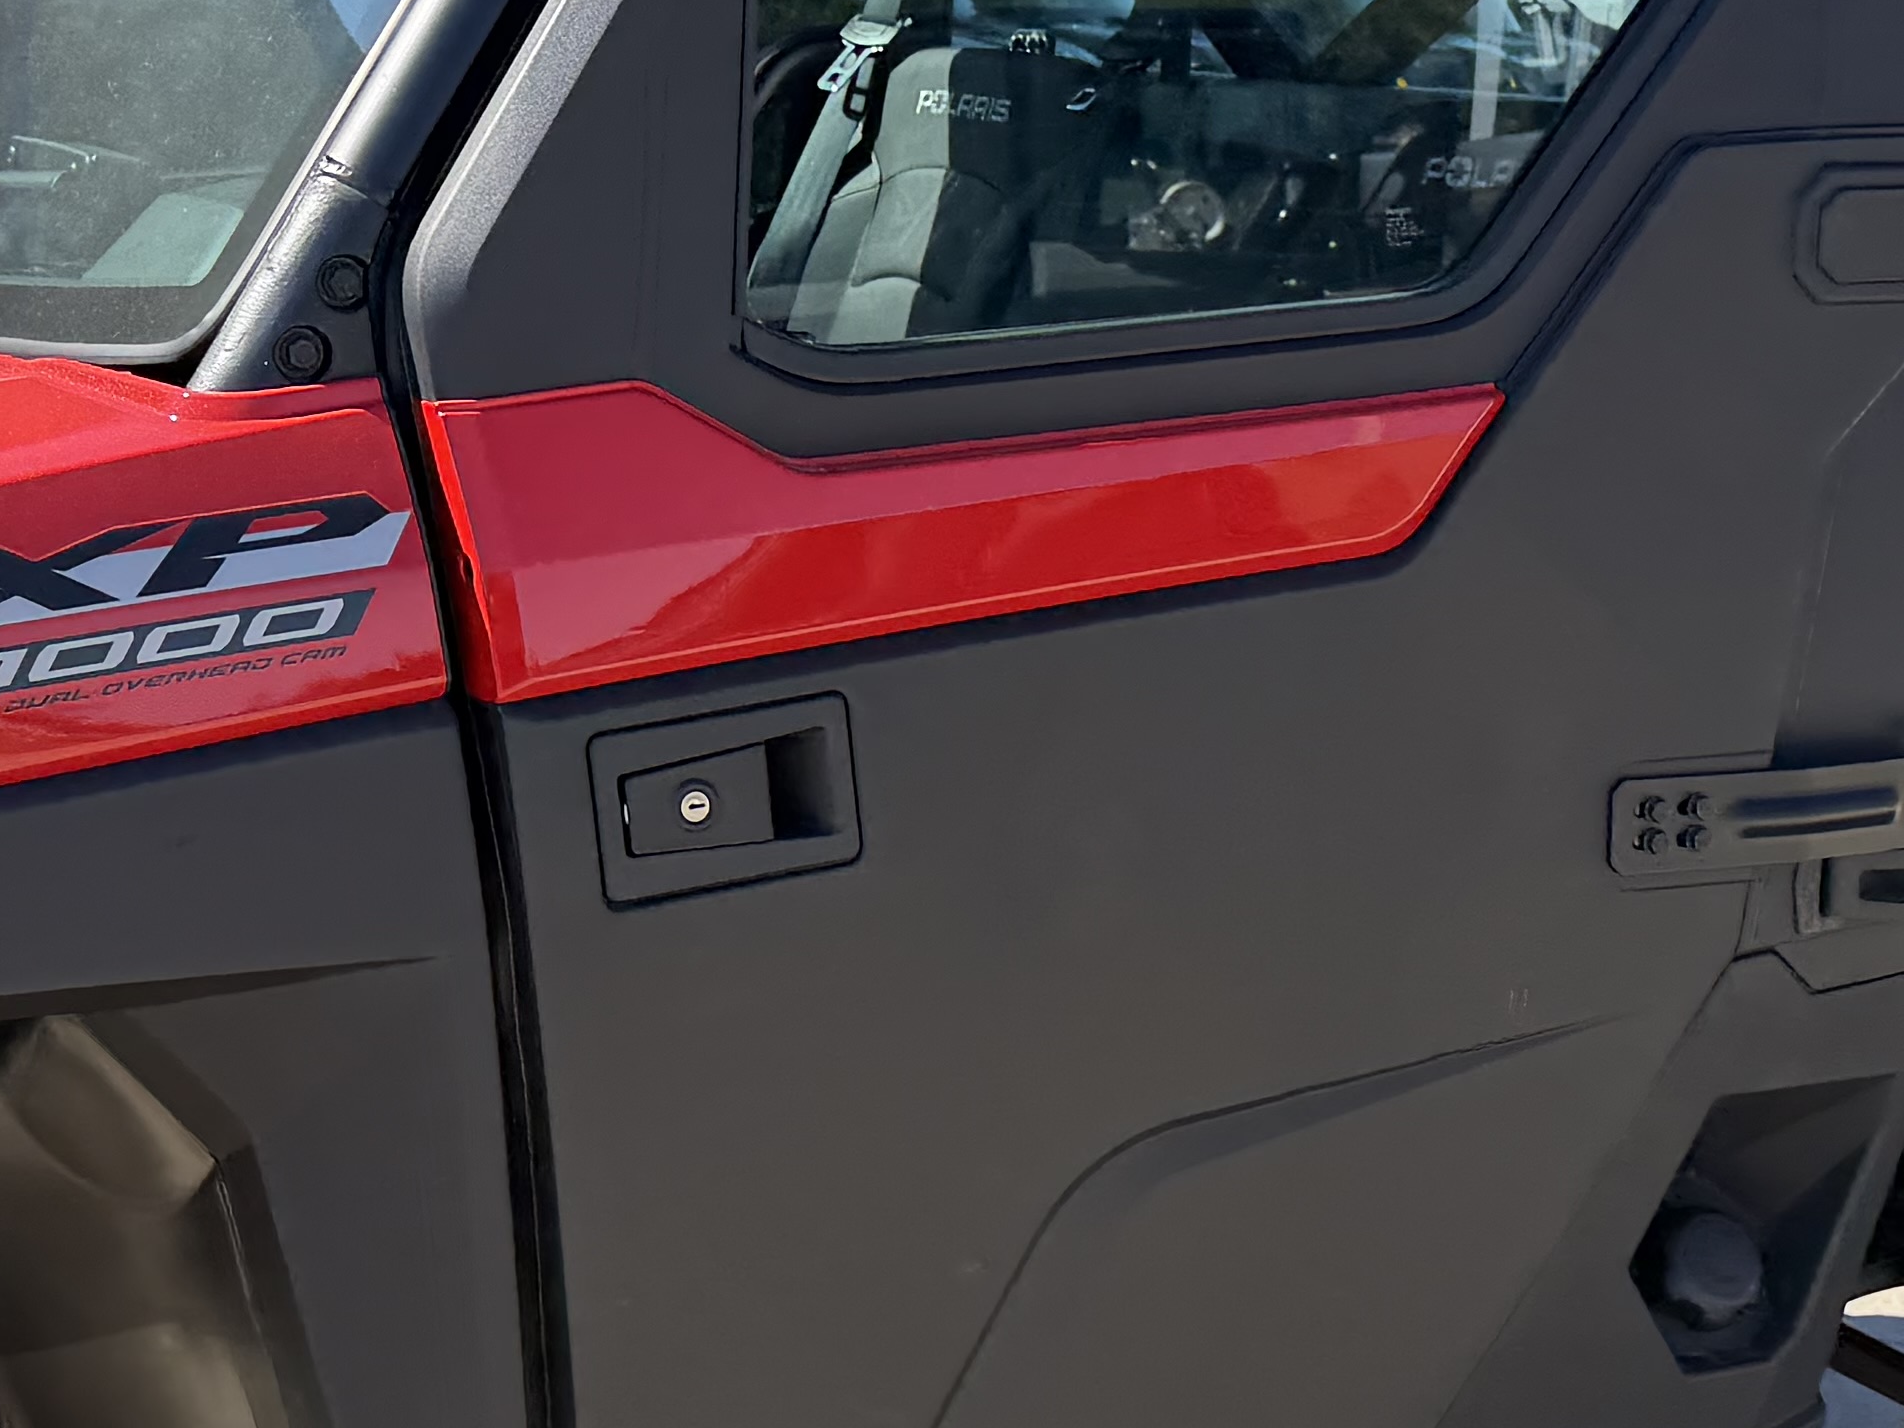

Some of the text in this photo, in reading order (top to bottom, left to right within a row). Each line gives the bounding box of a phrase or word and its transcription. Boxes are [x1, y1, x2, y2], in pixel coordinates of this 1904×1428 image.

[3, 643, 349, 713] DUAL OVERHEAD CAM
